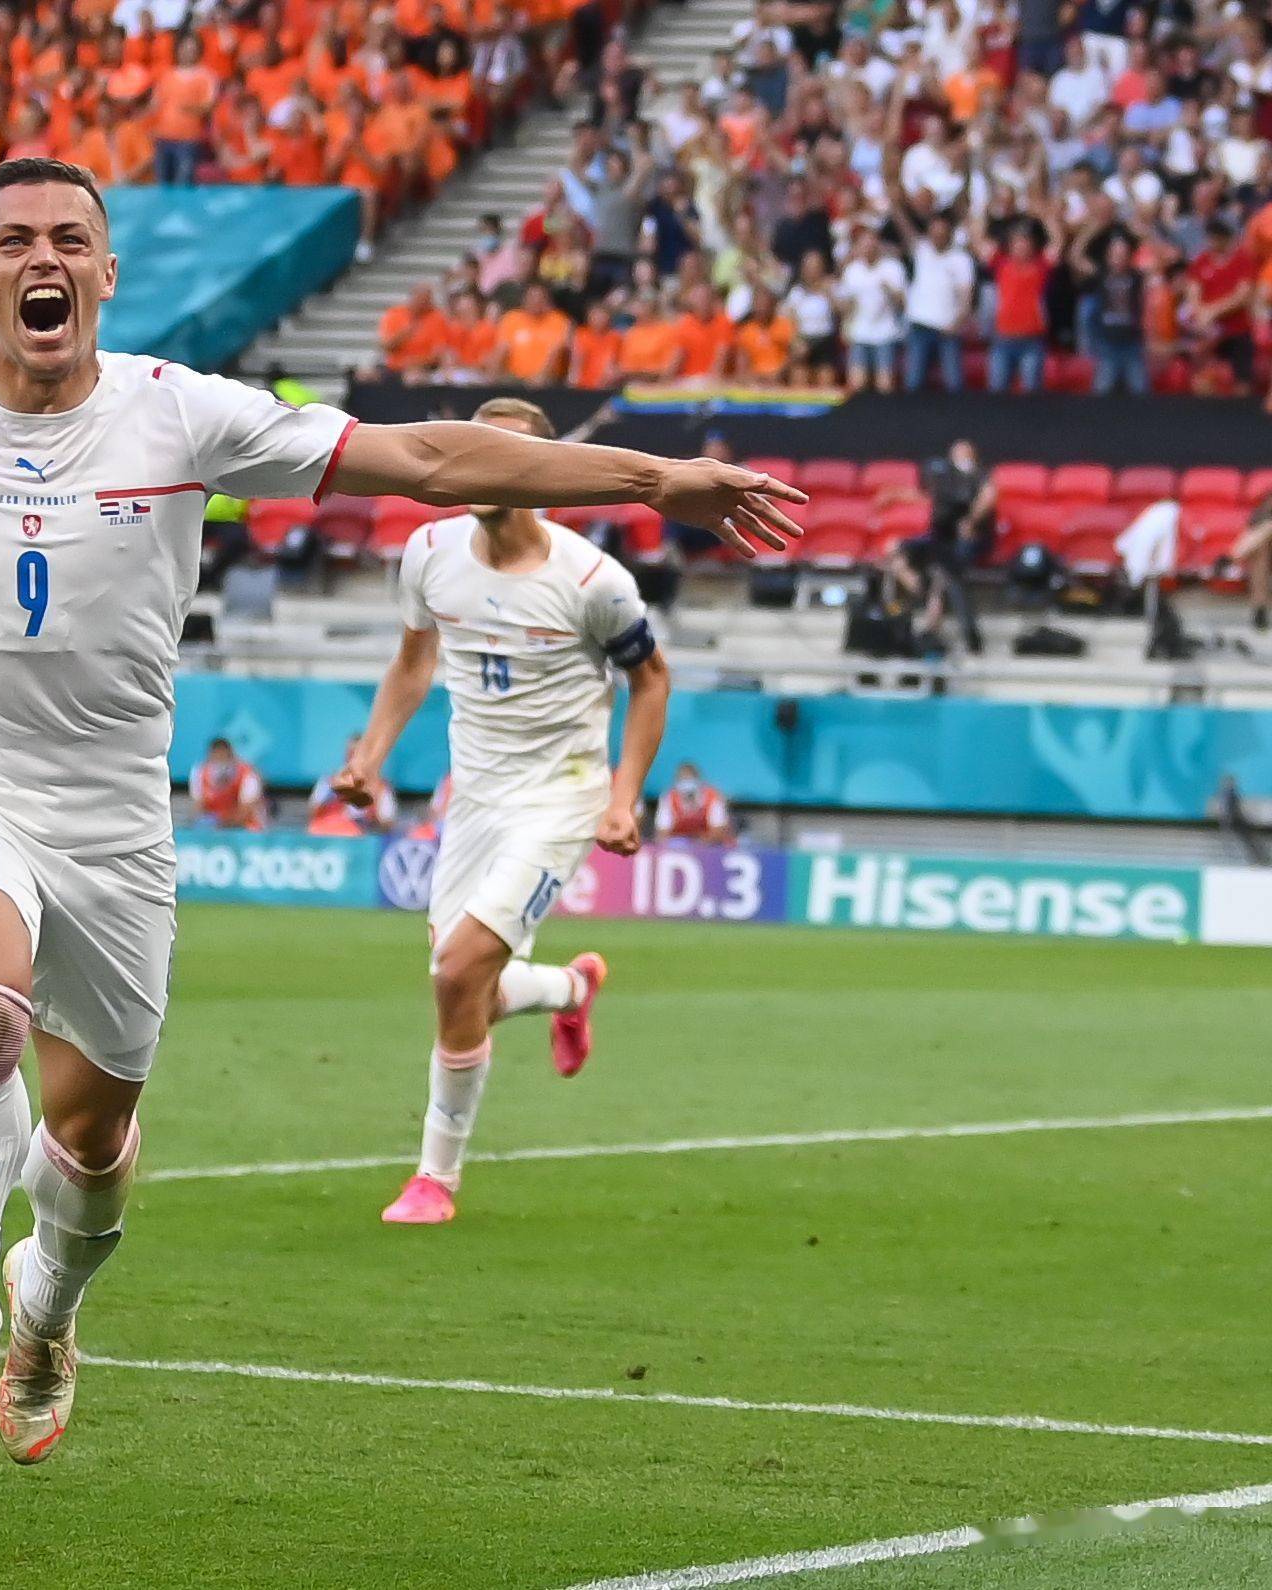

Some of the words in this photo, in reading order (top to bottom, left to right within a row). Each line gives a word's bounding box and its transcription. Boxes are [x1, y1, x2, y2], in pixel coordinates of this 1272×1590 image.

[25, 494, 78, 506] REPUBLIC
[17, 551, 49, 637] 9
[175, 844, 236, 888] RO
[238, 846, 345, 893] 2020
[523, 870, 562, 919] 15
[632, 851, 763, 920] ID.3
[808, 852, 1186, 940] Hisense
